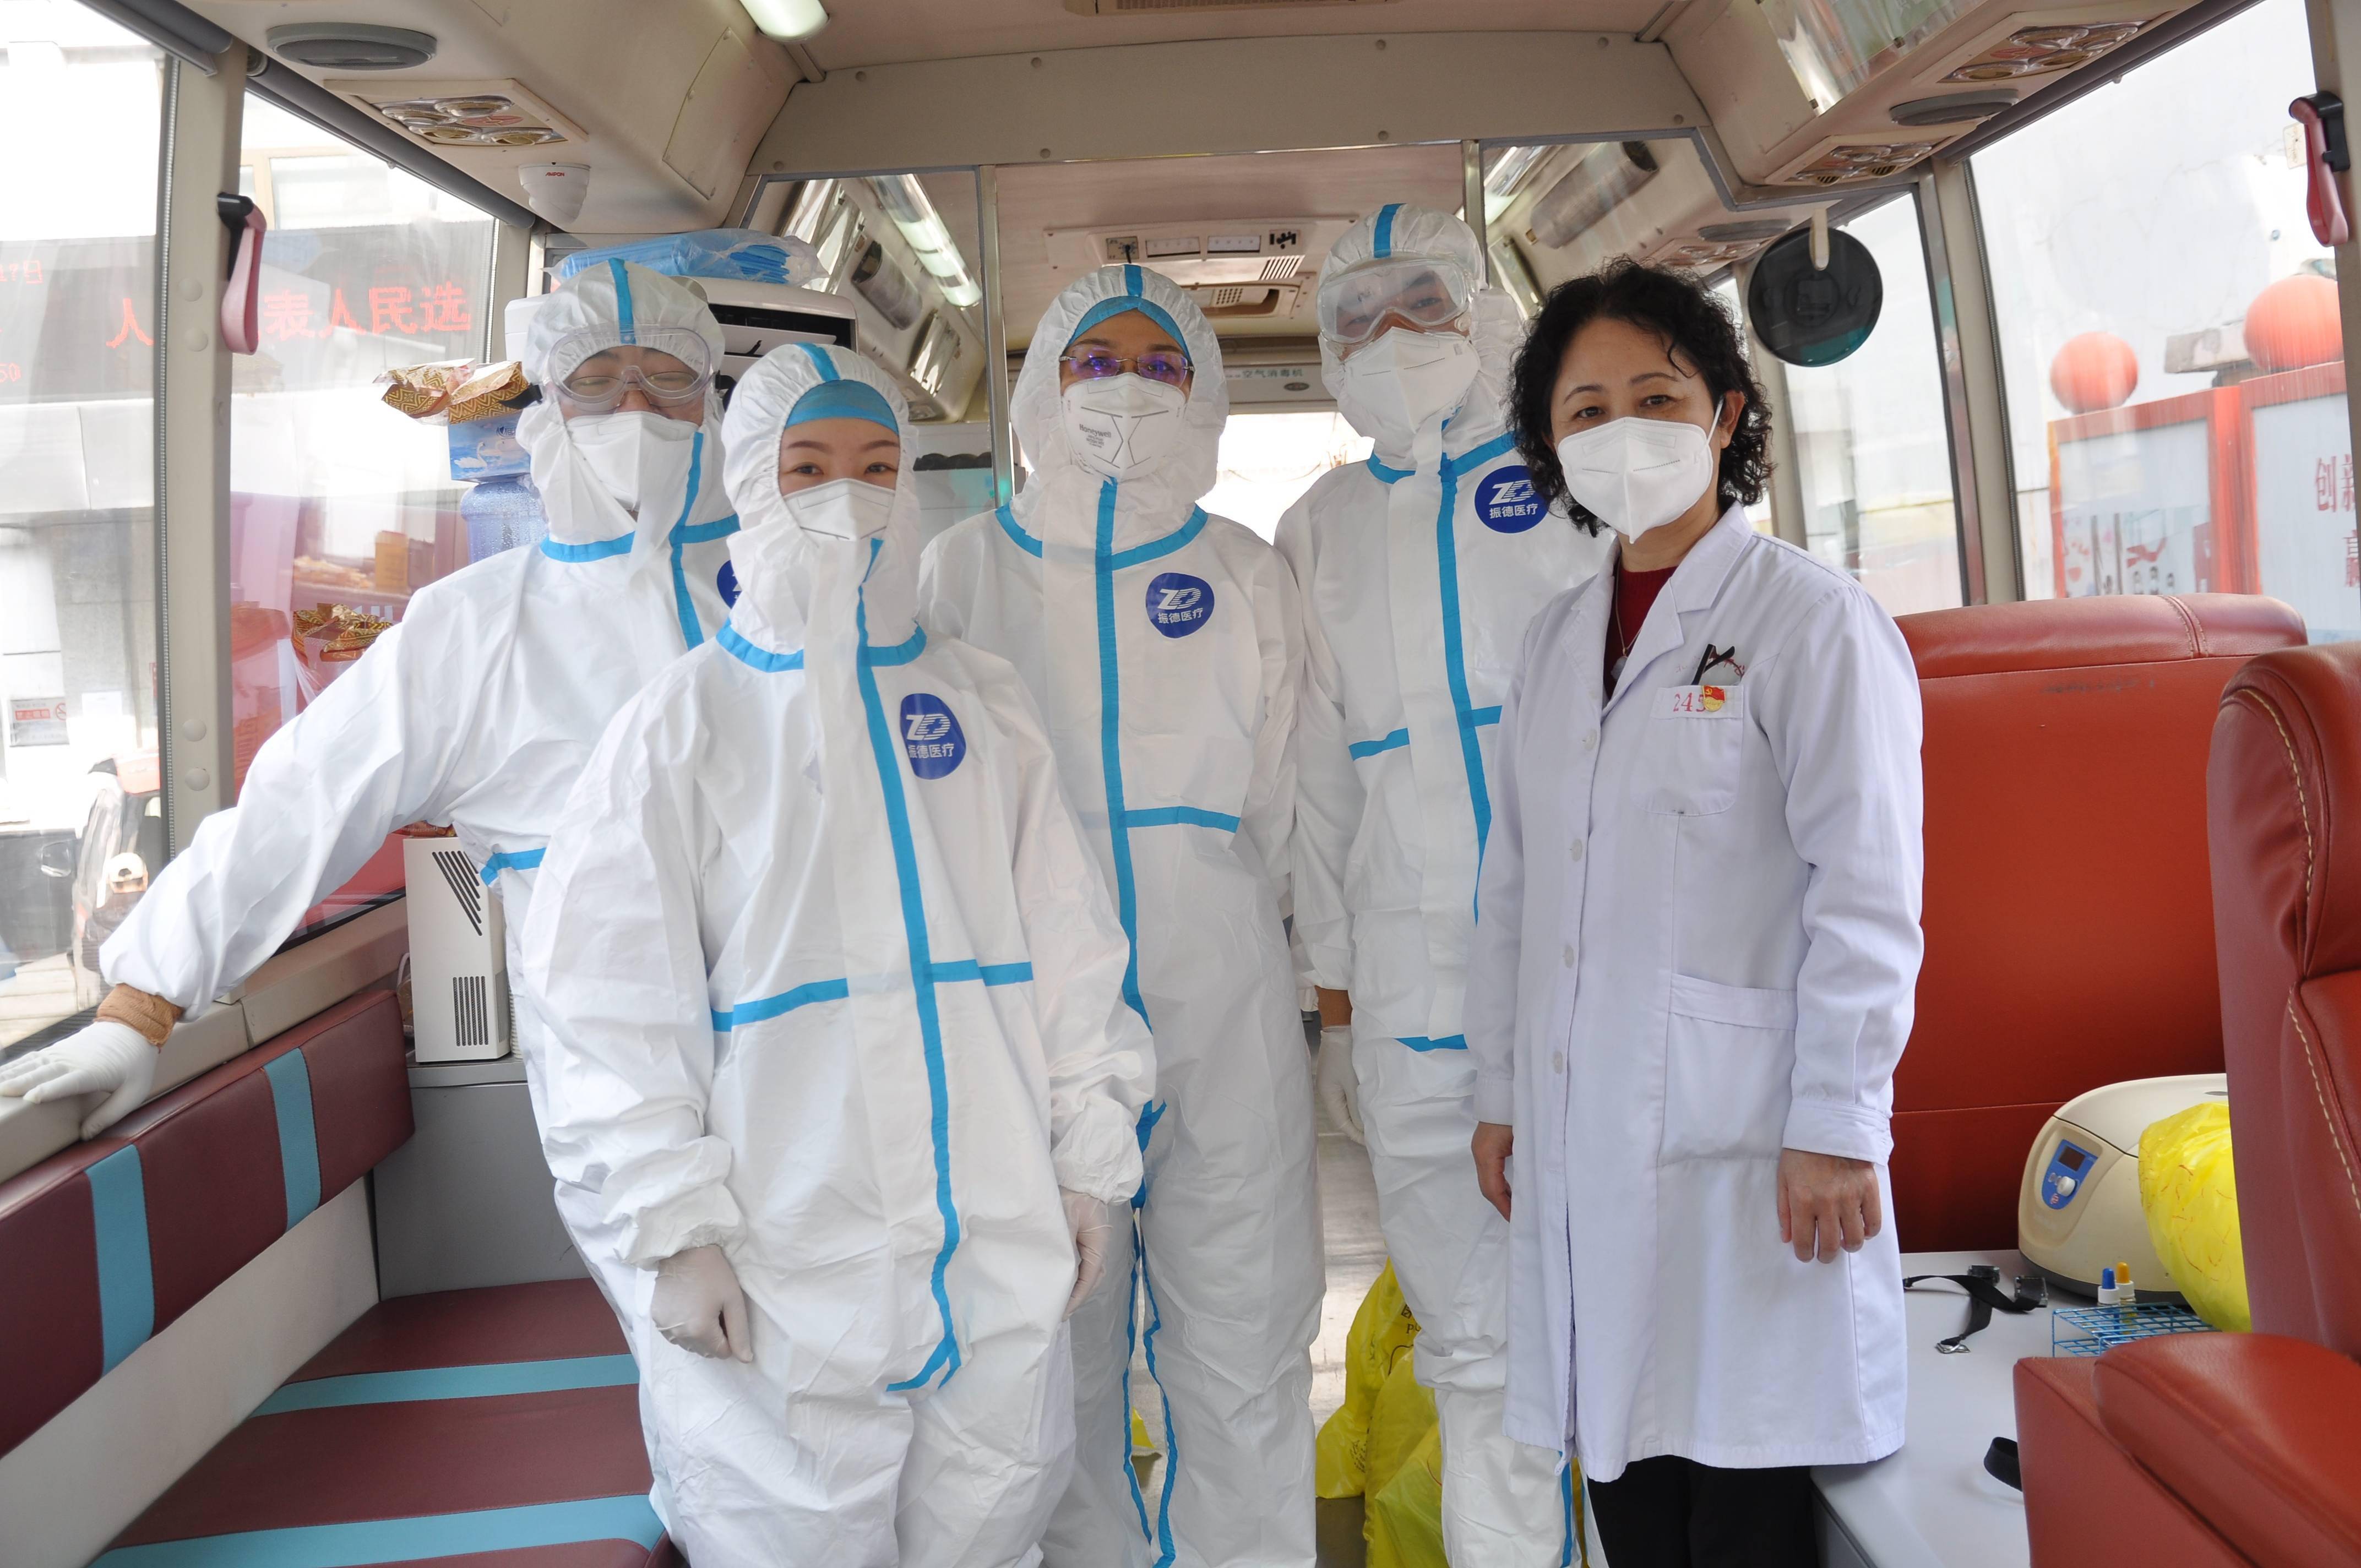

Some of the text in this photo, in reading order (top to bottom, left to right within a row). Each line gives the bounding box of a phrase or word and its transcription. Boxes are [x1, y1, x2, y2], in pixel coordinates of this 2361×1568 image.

[106, 281, 472, 349] 人 表人民选
[1079, 423, 1112, 438] Honeywell
[1489, 503, 1538, 519] 振德医疗
[1157, 608, 1204, 624] 振德医疗
